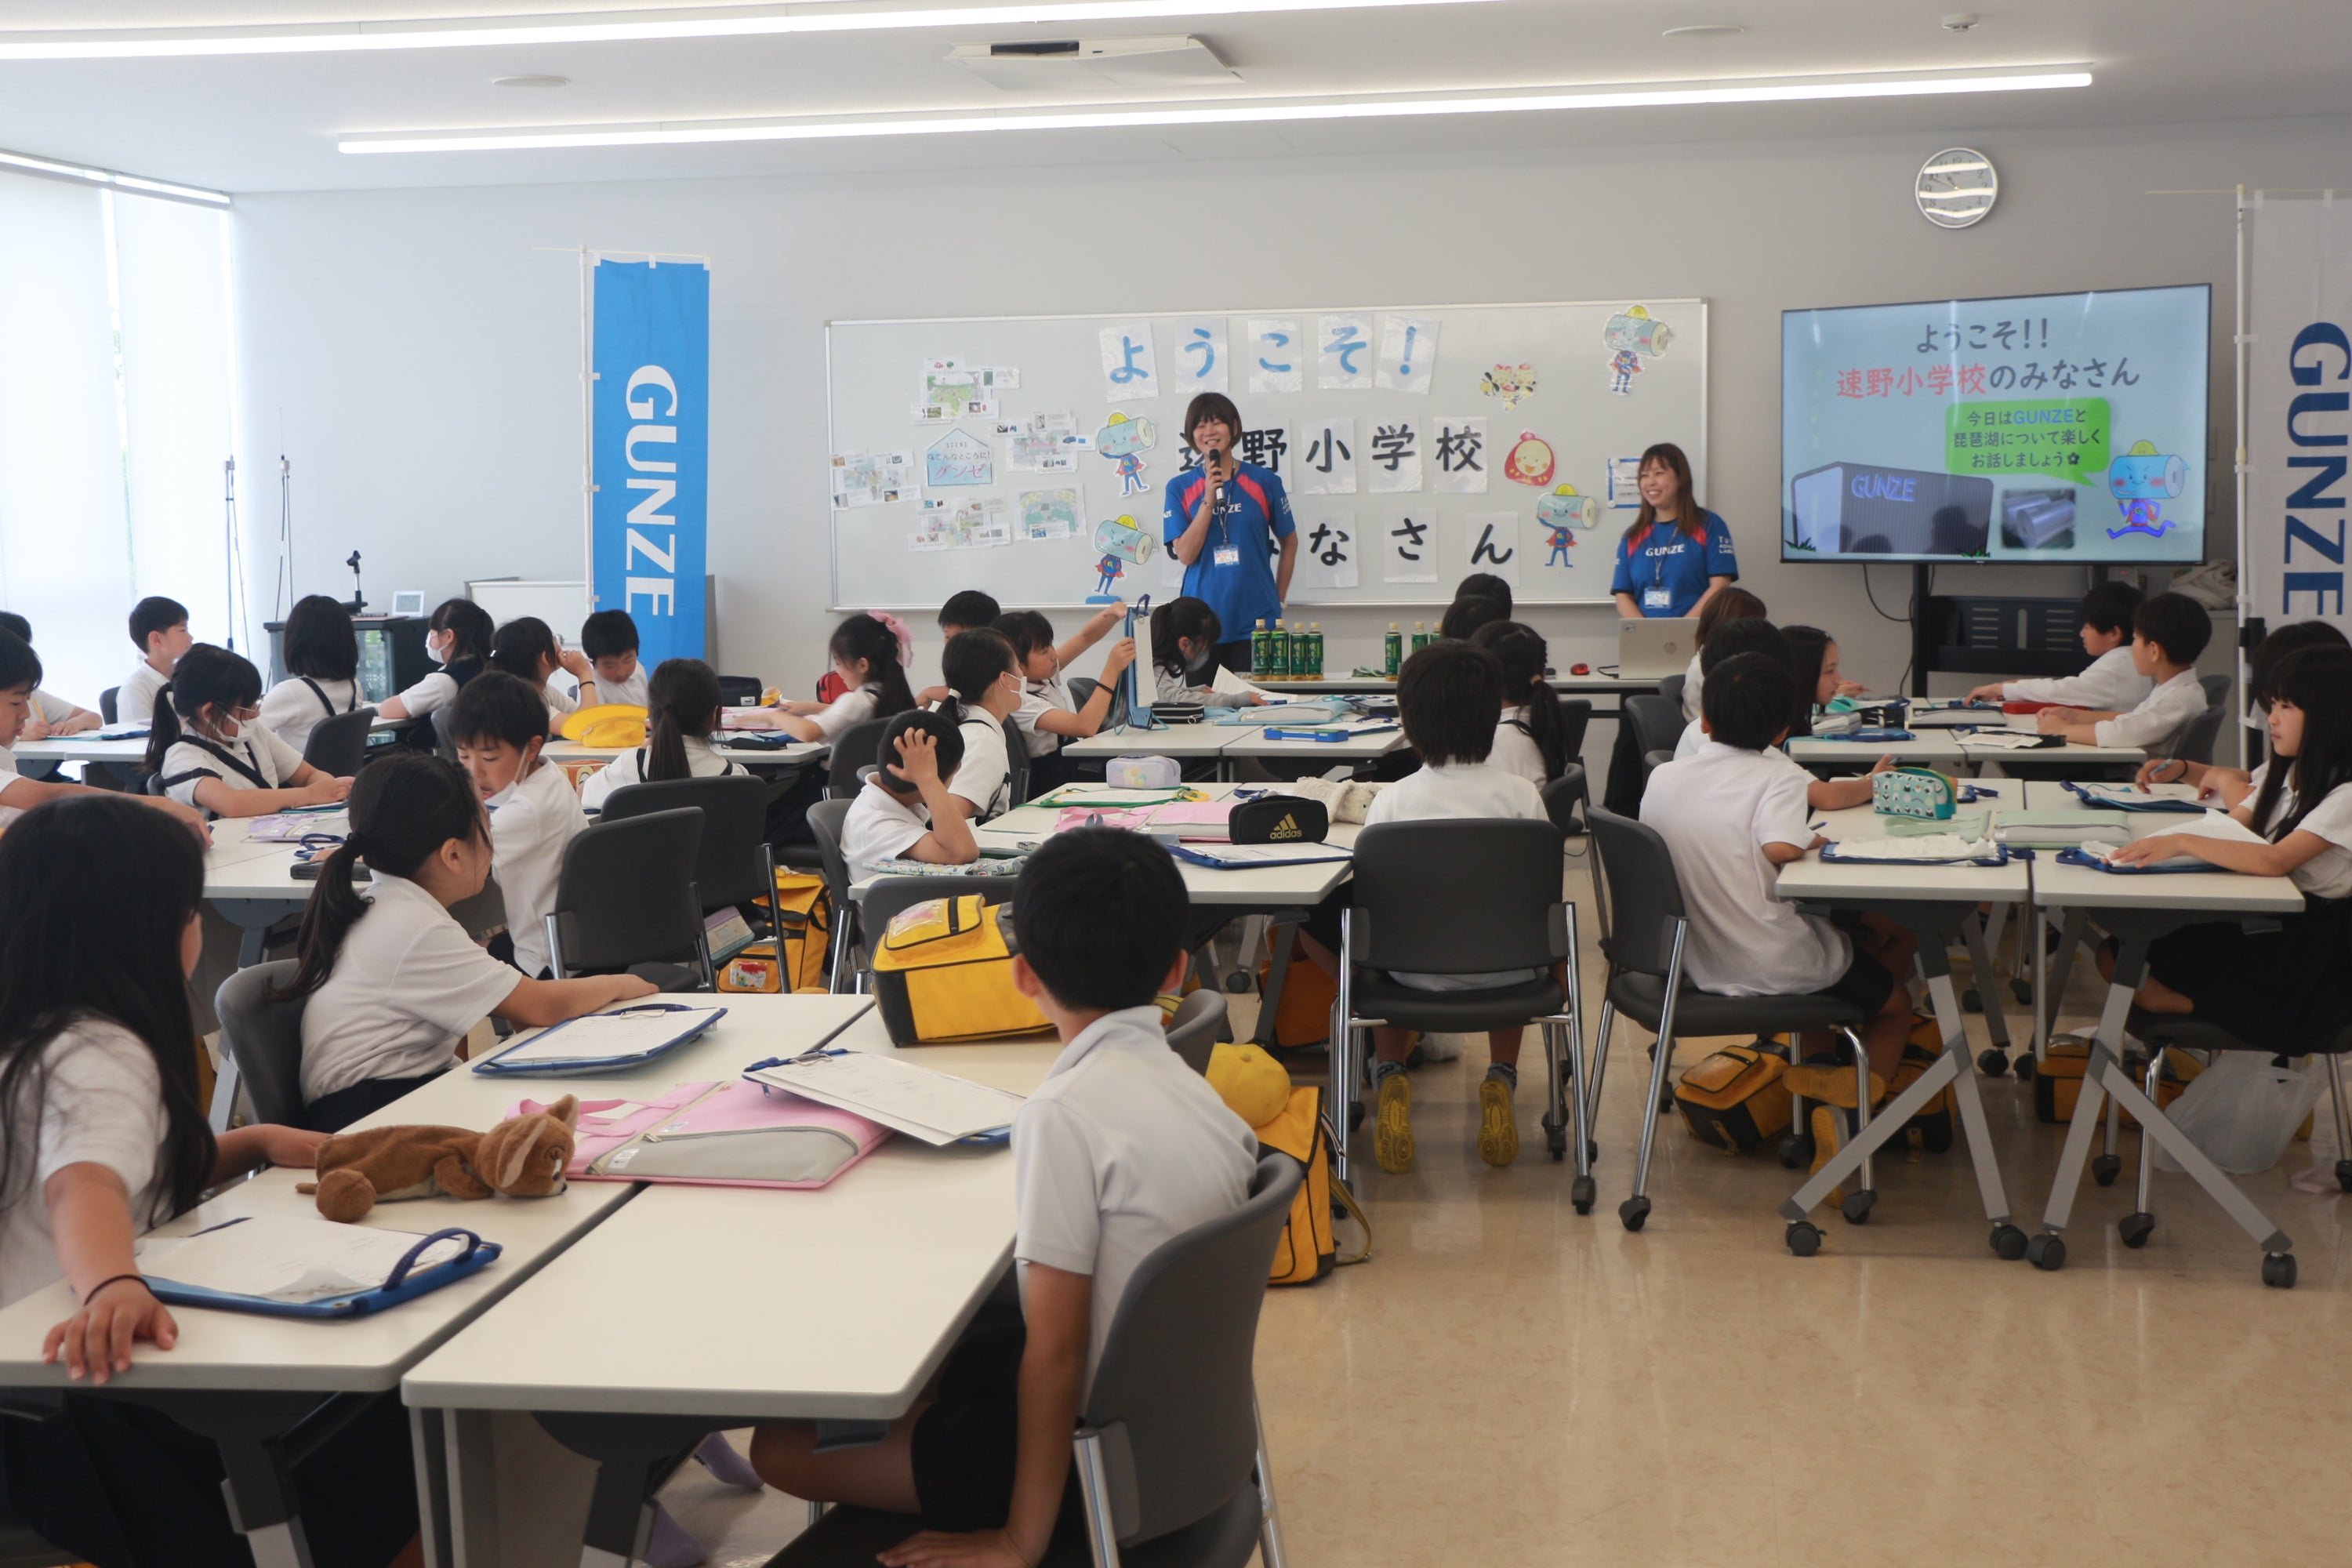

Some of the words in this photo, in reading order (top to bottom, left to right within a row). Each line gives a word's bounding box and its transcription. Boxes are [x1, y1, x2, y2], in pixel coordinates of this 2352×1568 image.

[1916, 318, 2049, 354] ようこそ!!
[1109, 326, 1417, 383] ようこそ!
[1836, 357, 2140, 398] 速野小学校のみなさん
[1966, 408, 2086, 427] 今日はGUNZEと
[1953, 428, 2101, 448] 琵琶湖について楽しく
[935, 463, 985, 481] グンゼ
[2282, 321, 2352, 615] GUNZE
[626, 365, 677, 616] GUNZE
[1851, 474, 1916, 502] GUNZE
[1212, 503, 1242, 515] UNZE
[1645, 543, 1685, 557] GUNZE
[1269, 828, 1302, 840] adidas
